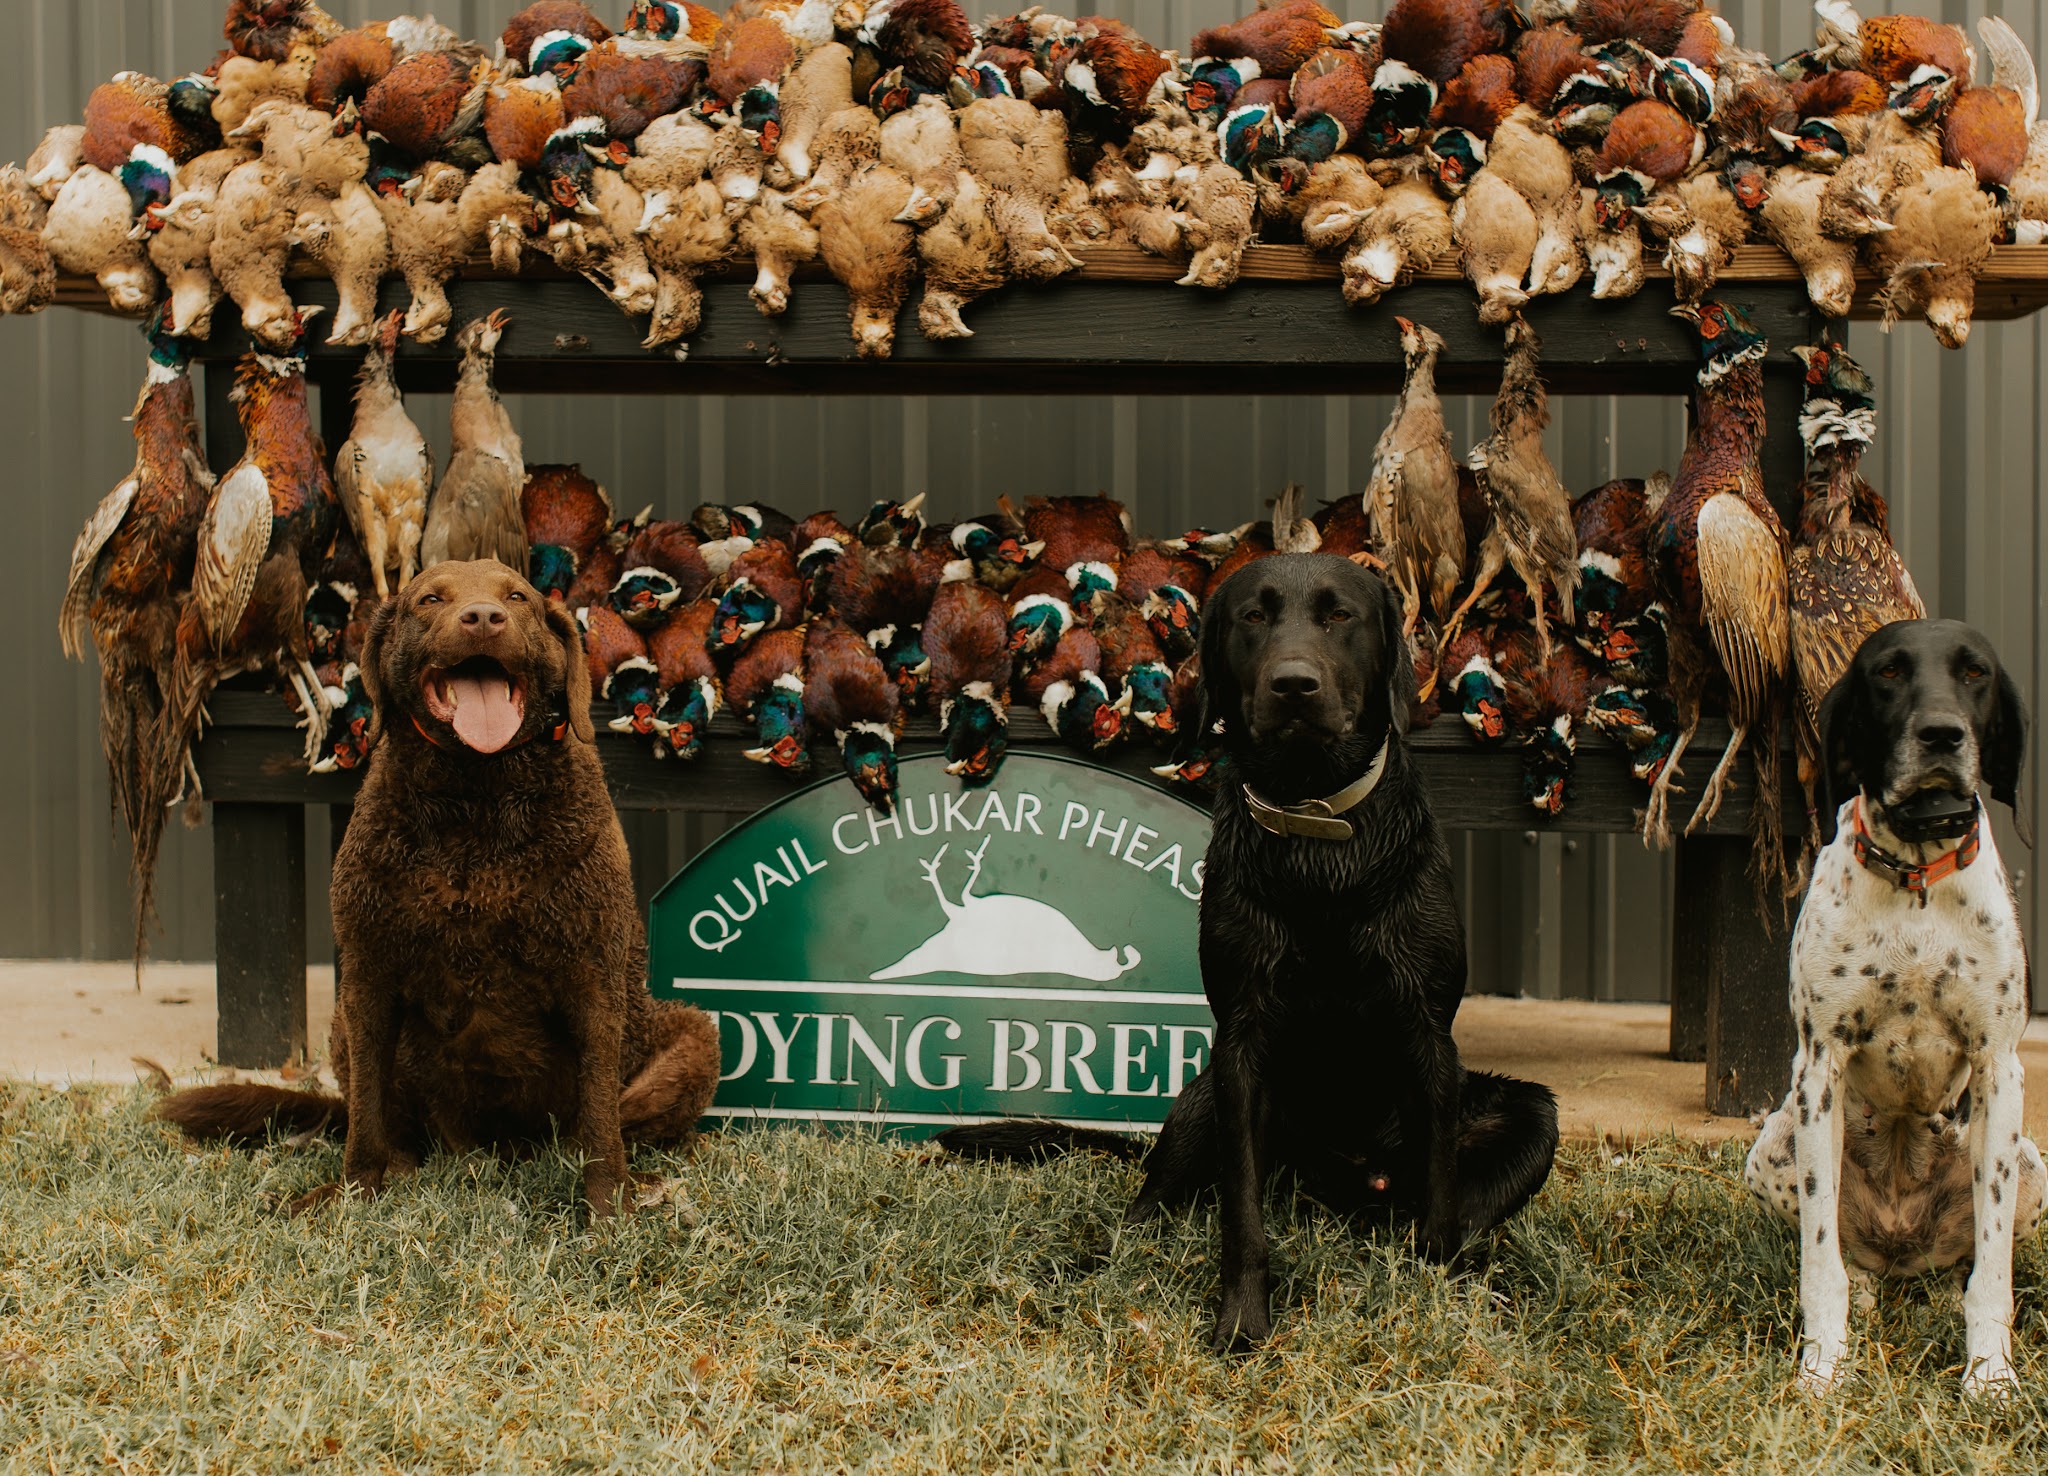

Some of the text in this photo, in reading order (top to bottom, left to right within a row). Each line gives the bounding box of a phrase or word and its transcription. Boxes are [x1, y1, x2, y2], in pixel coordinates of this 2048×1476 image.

[689, 838, 828, 953] QUAIL
[831, 791, 1044, 855] CHUKAR
[700, 1010, 967, 1088] DYING
